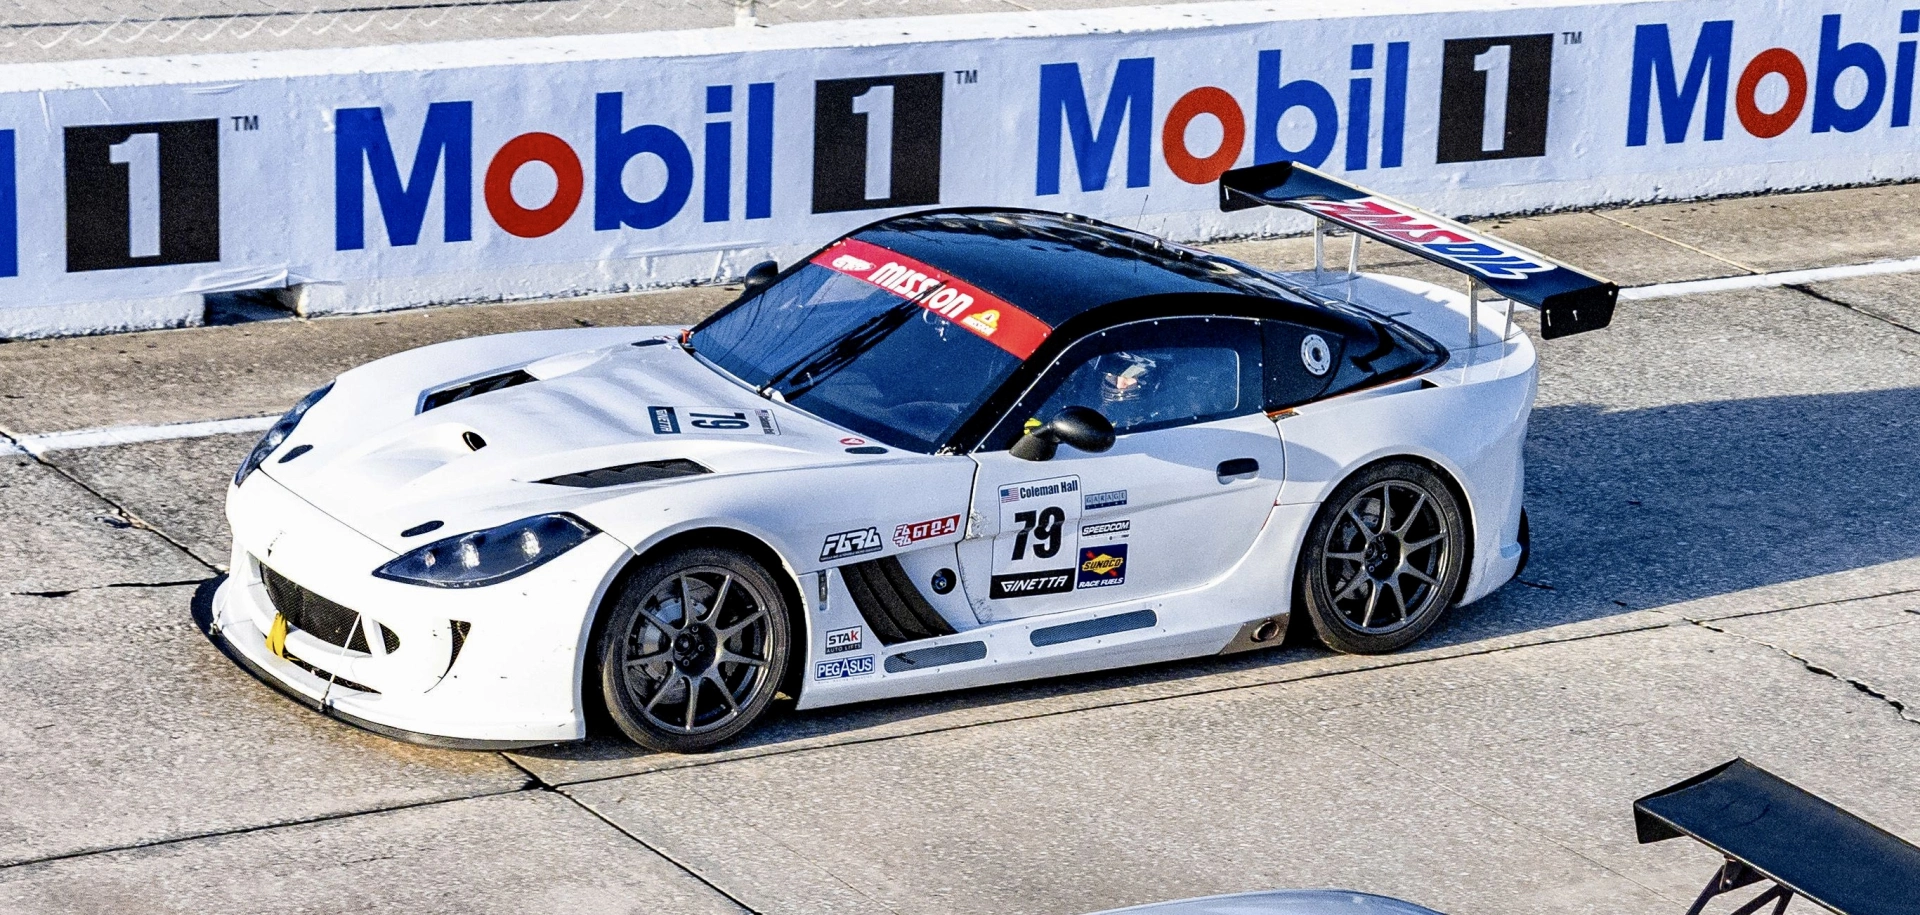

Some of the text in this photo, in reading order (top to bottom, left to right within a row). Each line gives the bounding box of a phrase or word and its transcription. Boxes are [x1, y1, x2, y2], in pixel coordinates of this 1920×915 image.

[1036, 41, 1410, 196] Mobil
[1473, 44, 1512, 152] 1
[335, 82, 775, 251] Mobil
[852, 85, 894, 200] 1
[109, 132, 161, 258] 1
[1309, 200, 1544, 277] AMSOIL
[689, 412, 750, 429] 79
[1020, 480, 1079, 499] Coleman Hall
[1086, 492, 1126, 504] GARAGE
[1011, 506, 1066, 561] 79
[1082, 522, 1130, 535] SPEEDCOM
[1083, 558, 1122, 570] SUNOCO
[1000, 575, 1069, 593] GINETTA
[1078, 577, 1124, 588] RACE FUELS
[826, 646, 843, 654] AUTO
[817, 658, 872, 677] PEGASUS
